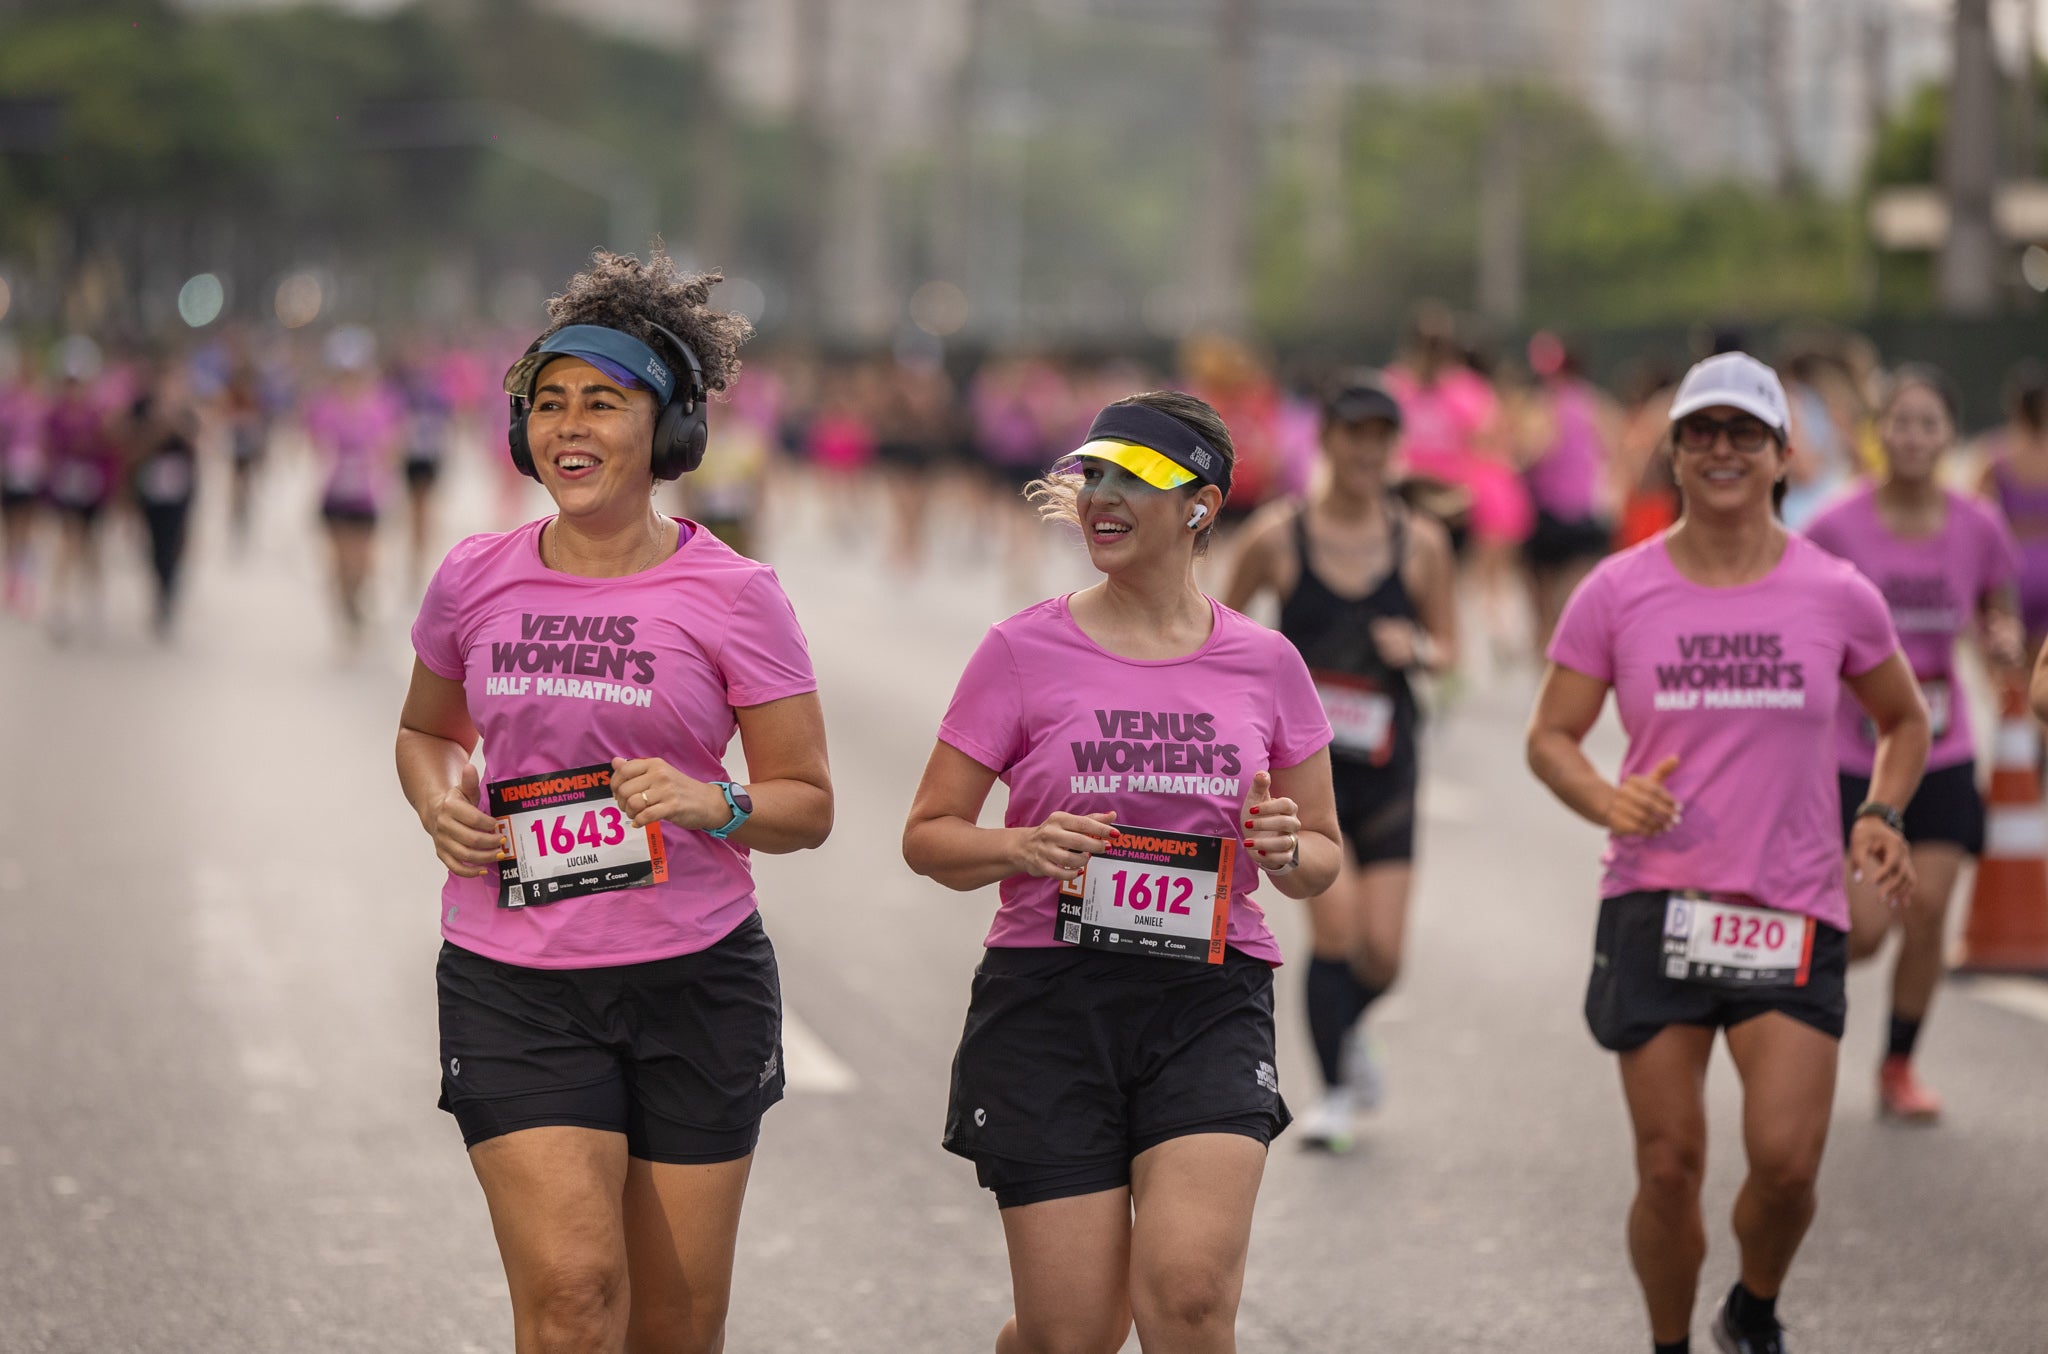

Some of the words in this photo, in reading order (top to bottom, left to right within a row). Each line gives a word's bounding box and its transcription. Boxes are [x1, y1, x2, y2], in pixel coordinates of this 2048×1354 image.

[1195, 445, 1212, 463] TRACK
[521, 613, 639, 646] VENUS
[1677, 634, 1784, 659] VENUS
[492, 641, 657, 685] WOMEN'S
[1655, 663, 1805, 689] WOMEN'S
[486, 677, 532, 696] HALF
[536, 677, 653, 708] MARATHON
[1653, 690, 1700, 711] HALF
[1703, 688, 1805, 710] MARATHON
[1094, 709, 1217, 742] VENUS
[1070, 740, 1242, 776] WOMEN'S
[500, 771, 611, 802] VENUSWOMEN'S
[1070, 775, 1122, 794] HALF
[1127, 775, 1240, 797] MARATHON
[522, 798, 541, 808] HALF
[541, 791, 586, 805] MARATHON
[530, 806, 626, 857] 1643
[566, 853, 599, 868] LUCIANA
[653, 857, 665, 874] 1643
[1106, 847, 1126, 857] HALF
[1127, 850, 1171, 863] MARATHON
[502, 867, 519, 880] 21.1K
[579, 877, 599, 885] Jeep
[1112, 870, 1194, 916] 1612
[1216, 885, 1228, 900] 1612
[1060, 902, 1082, 917] 21.1K
[1134, 914, 1164, 928] DANIELE
[1711, 914, 1785, 949] 1320
[1139, 937, 1158, 947] Jeep
[1210, 939, 1222, 954] 1612
